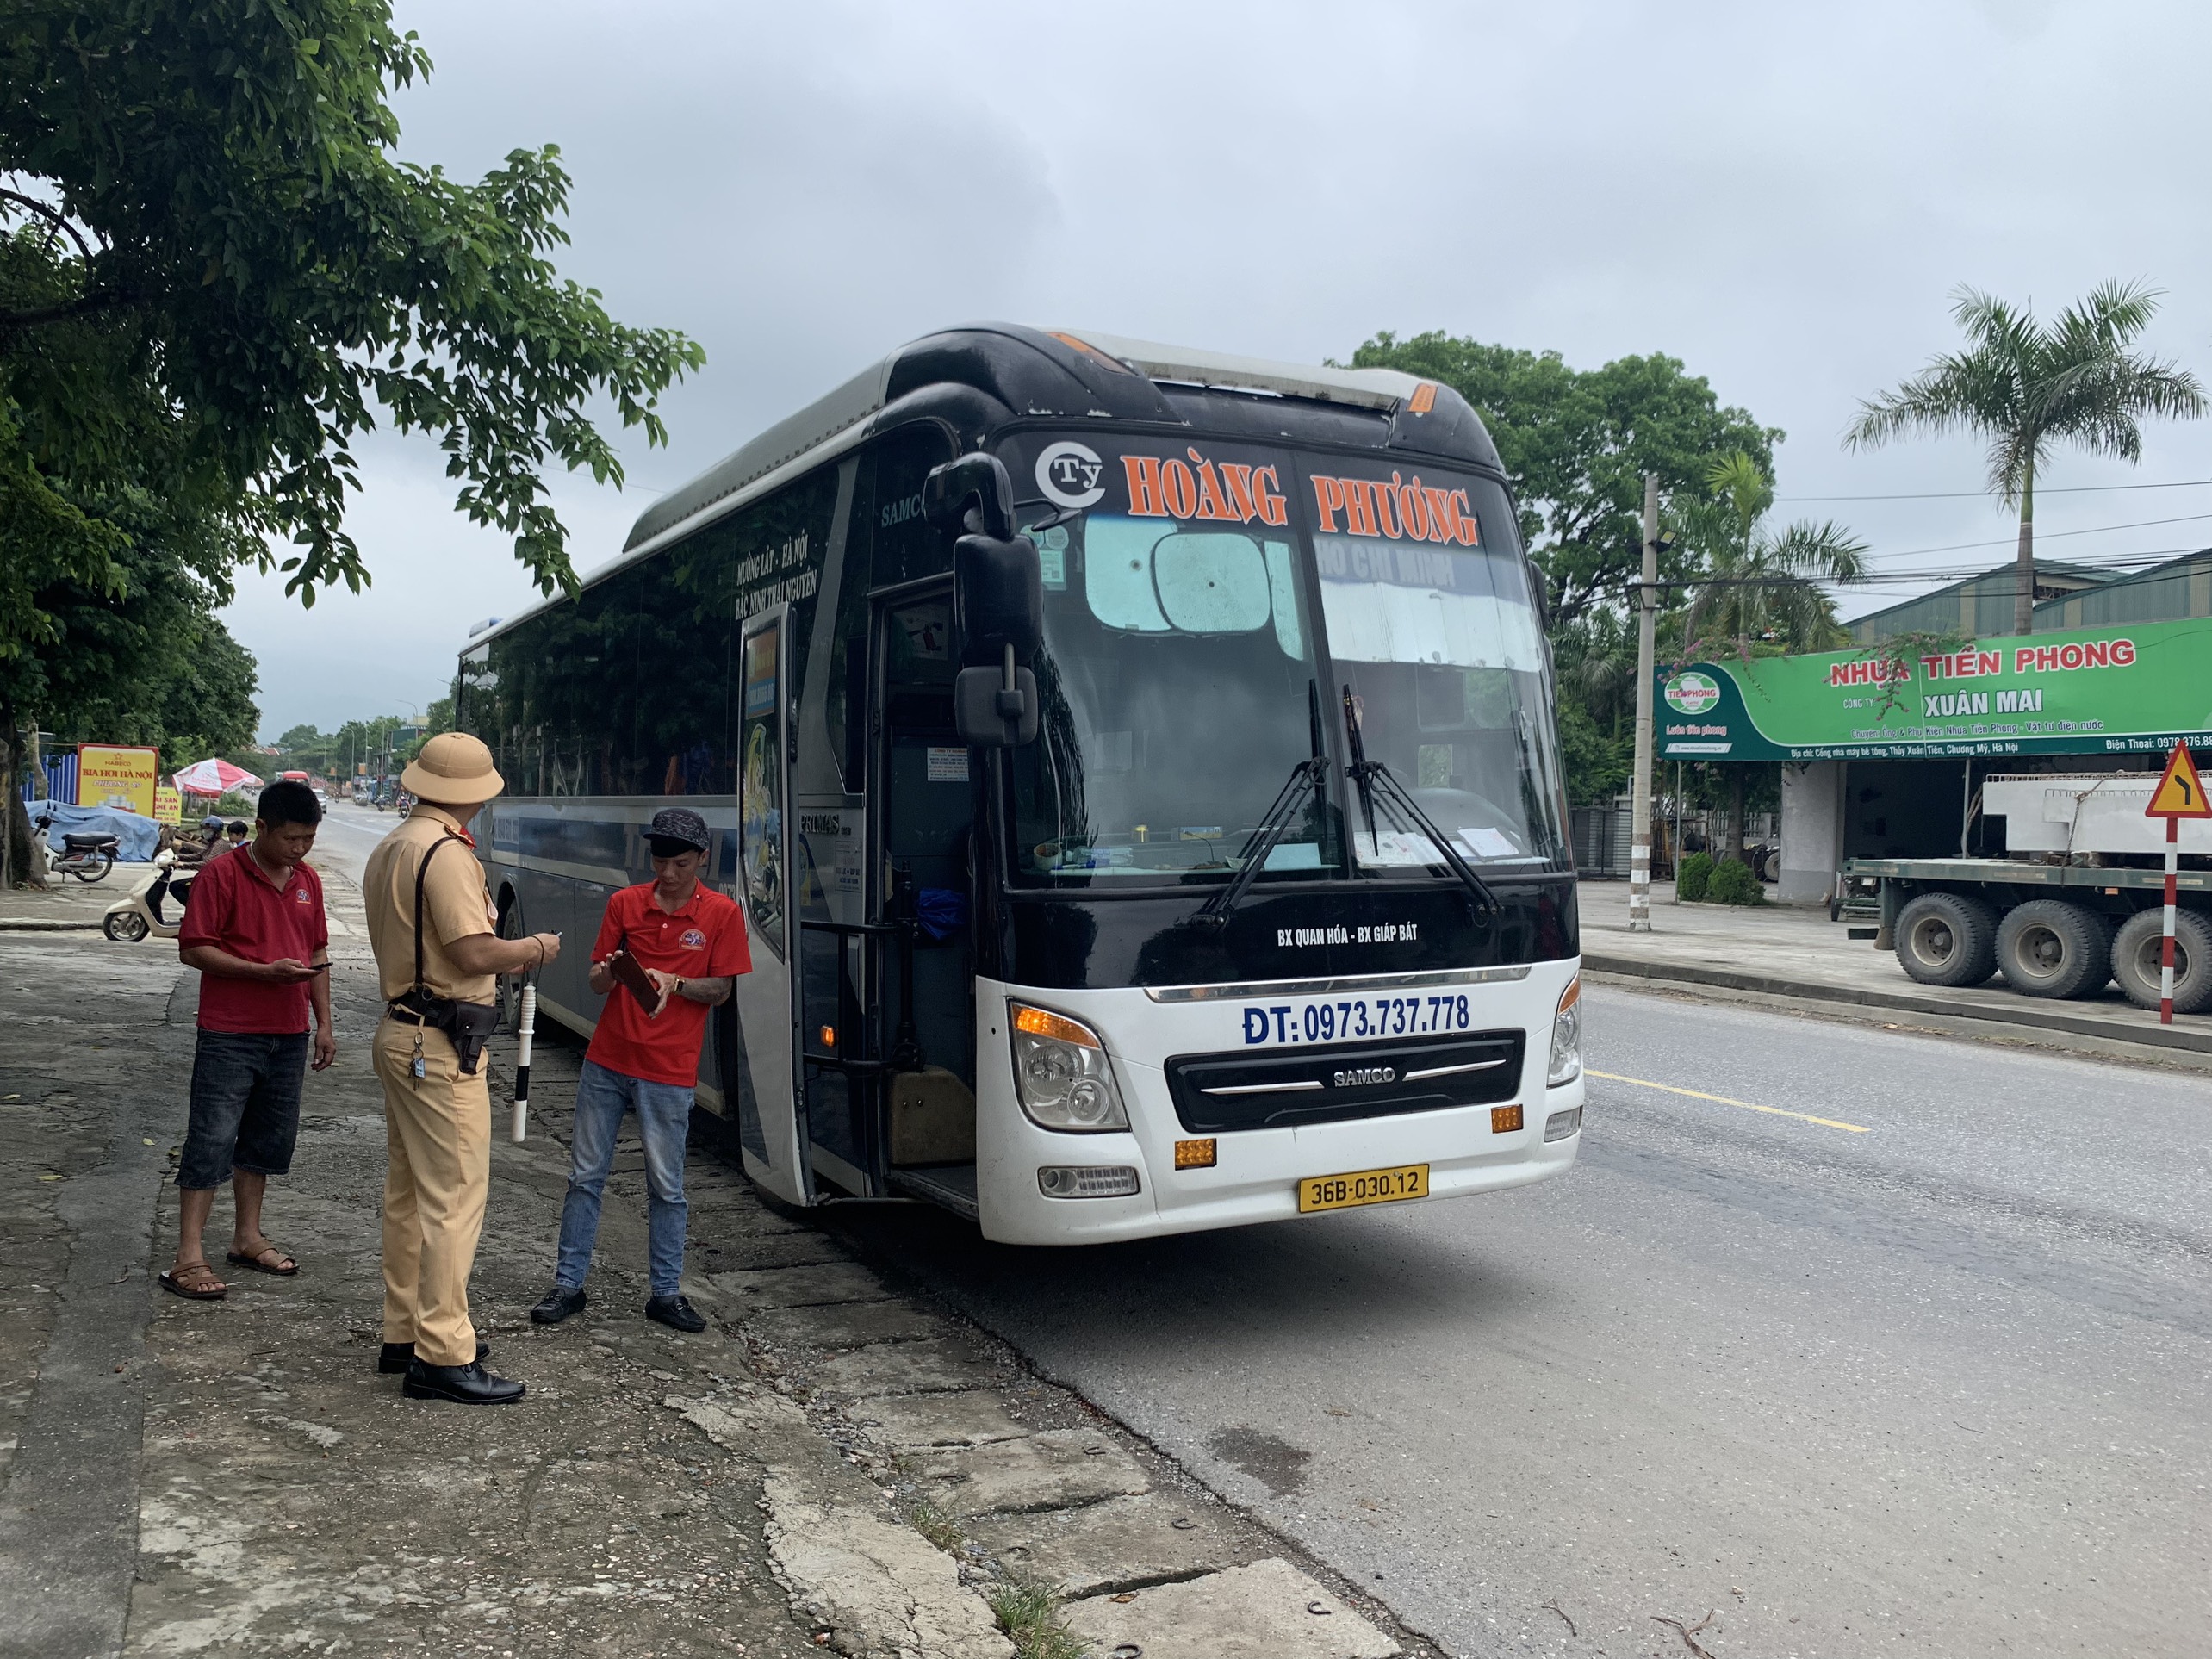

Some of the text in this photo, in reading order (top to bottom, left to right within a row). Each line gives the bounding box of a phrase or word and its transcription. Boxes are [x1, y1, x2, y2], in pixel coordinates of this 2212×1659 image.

[1120, 446, 1288, 526] HOÀNG
[1309, 469, 1478, 546] PHƯƠNG
[781, 536, 792, 569] HÀ
[794, 527, 808, 567] NỘI
[2015, 638, 2137, 674] PHONG
[1924, 690, 1988, 718] XUÂN
[1996, 688, 2043, 714] MAI
[1991, 724, 2018, 736] Phong
[2080, 719, 2104, 730] nước
[1946, 744, 1974, 755] Chương
[1992, 743, 2003, 753] Hà
[2005, 743, 2019, 753] Nội
[2106, 739, 2126, 751] Điện
[2127, 738, 2154, 750] Thoại:
[118, 769, 134, 779] HÀ
[135, 770, 152, 780] NỘI
[799, 813, 840, 834] PRIMAS
[1277, 929, 1294, 947] BX
[1295, 928, 1325, 948] QUAN
[1327, 924, 1349, 944] HÓA
[1357, 926, 1372, 943] BX
[1373, 922, 1397, 942] GIÁP
[1399, 921, 1418, 941] BÁT
[1333, 1067, 1395, 1087] SAMCO
[1311, 1171, 1419, 1205] 36B-030.12
